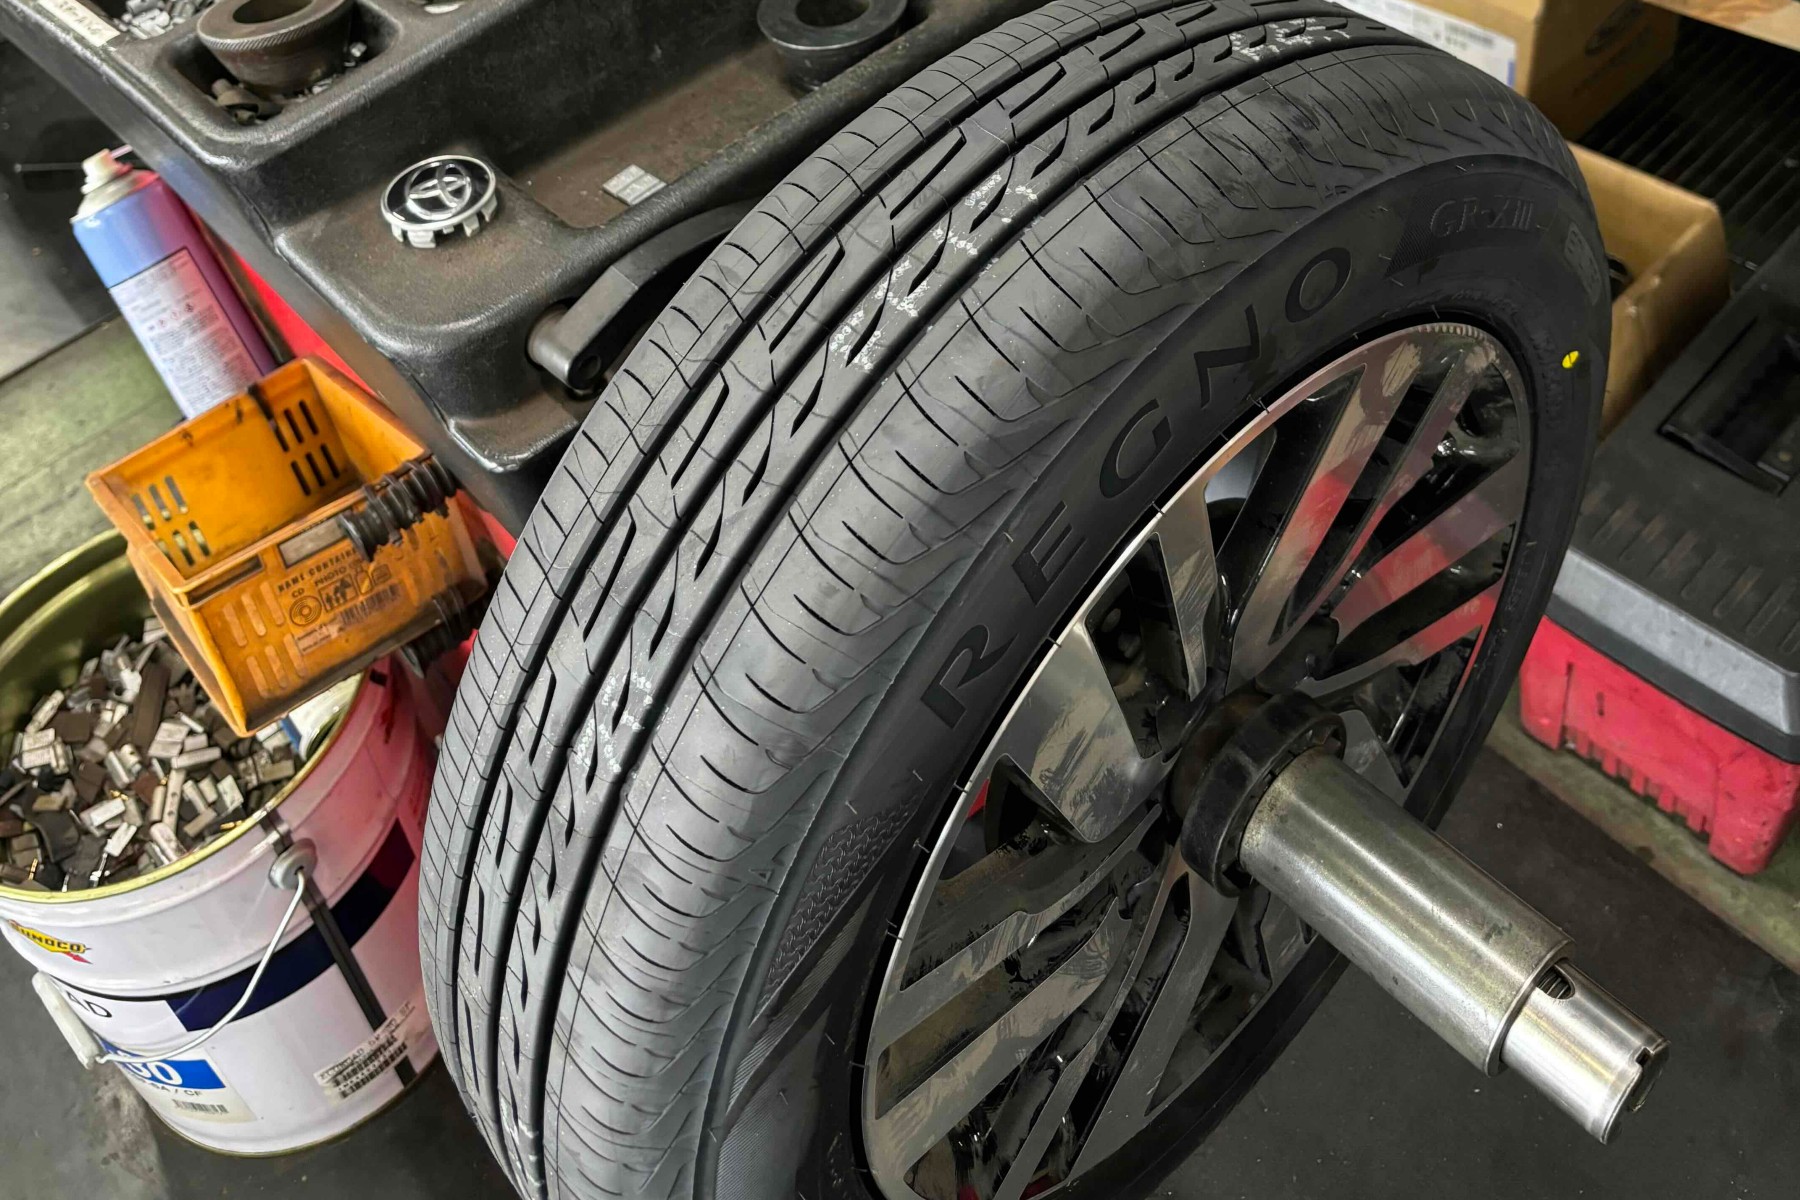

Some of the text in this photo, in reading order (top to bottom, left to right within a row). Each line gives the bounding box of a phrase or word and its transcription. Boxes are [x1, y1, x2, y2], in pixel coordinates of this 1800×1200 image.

[920, 246, 1353, 730] REGNO
[278, 573, 305, 593] NAME
[315, 566, 346, 587] PHOTO
[292, 587, 305, 598] CD
